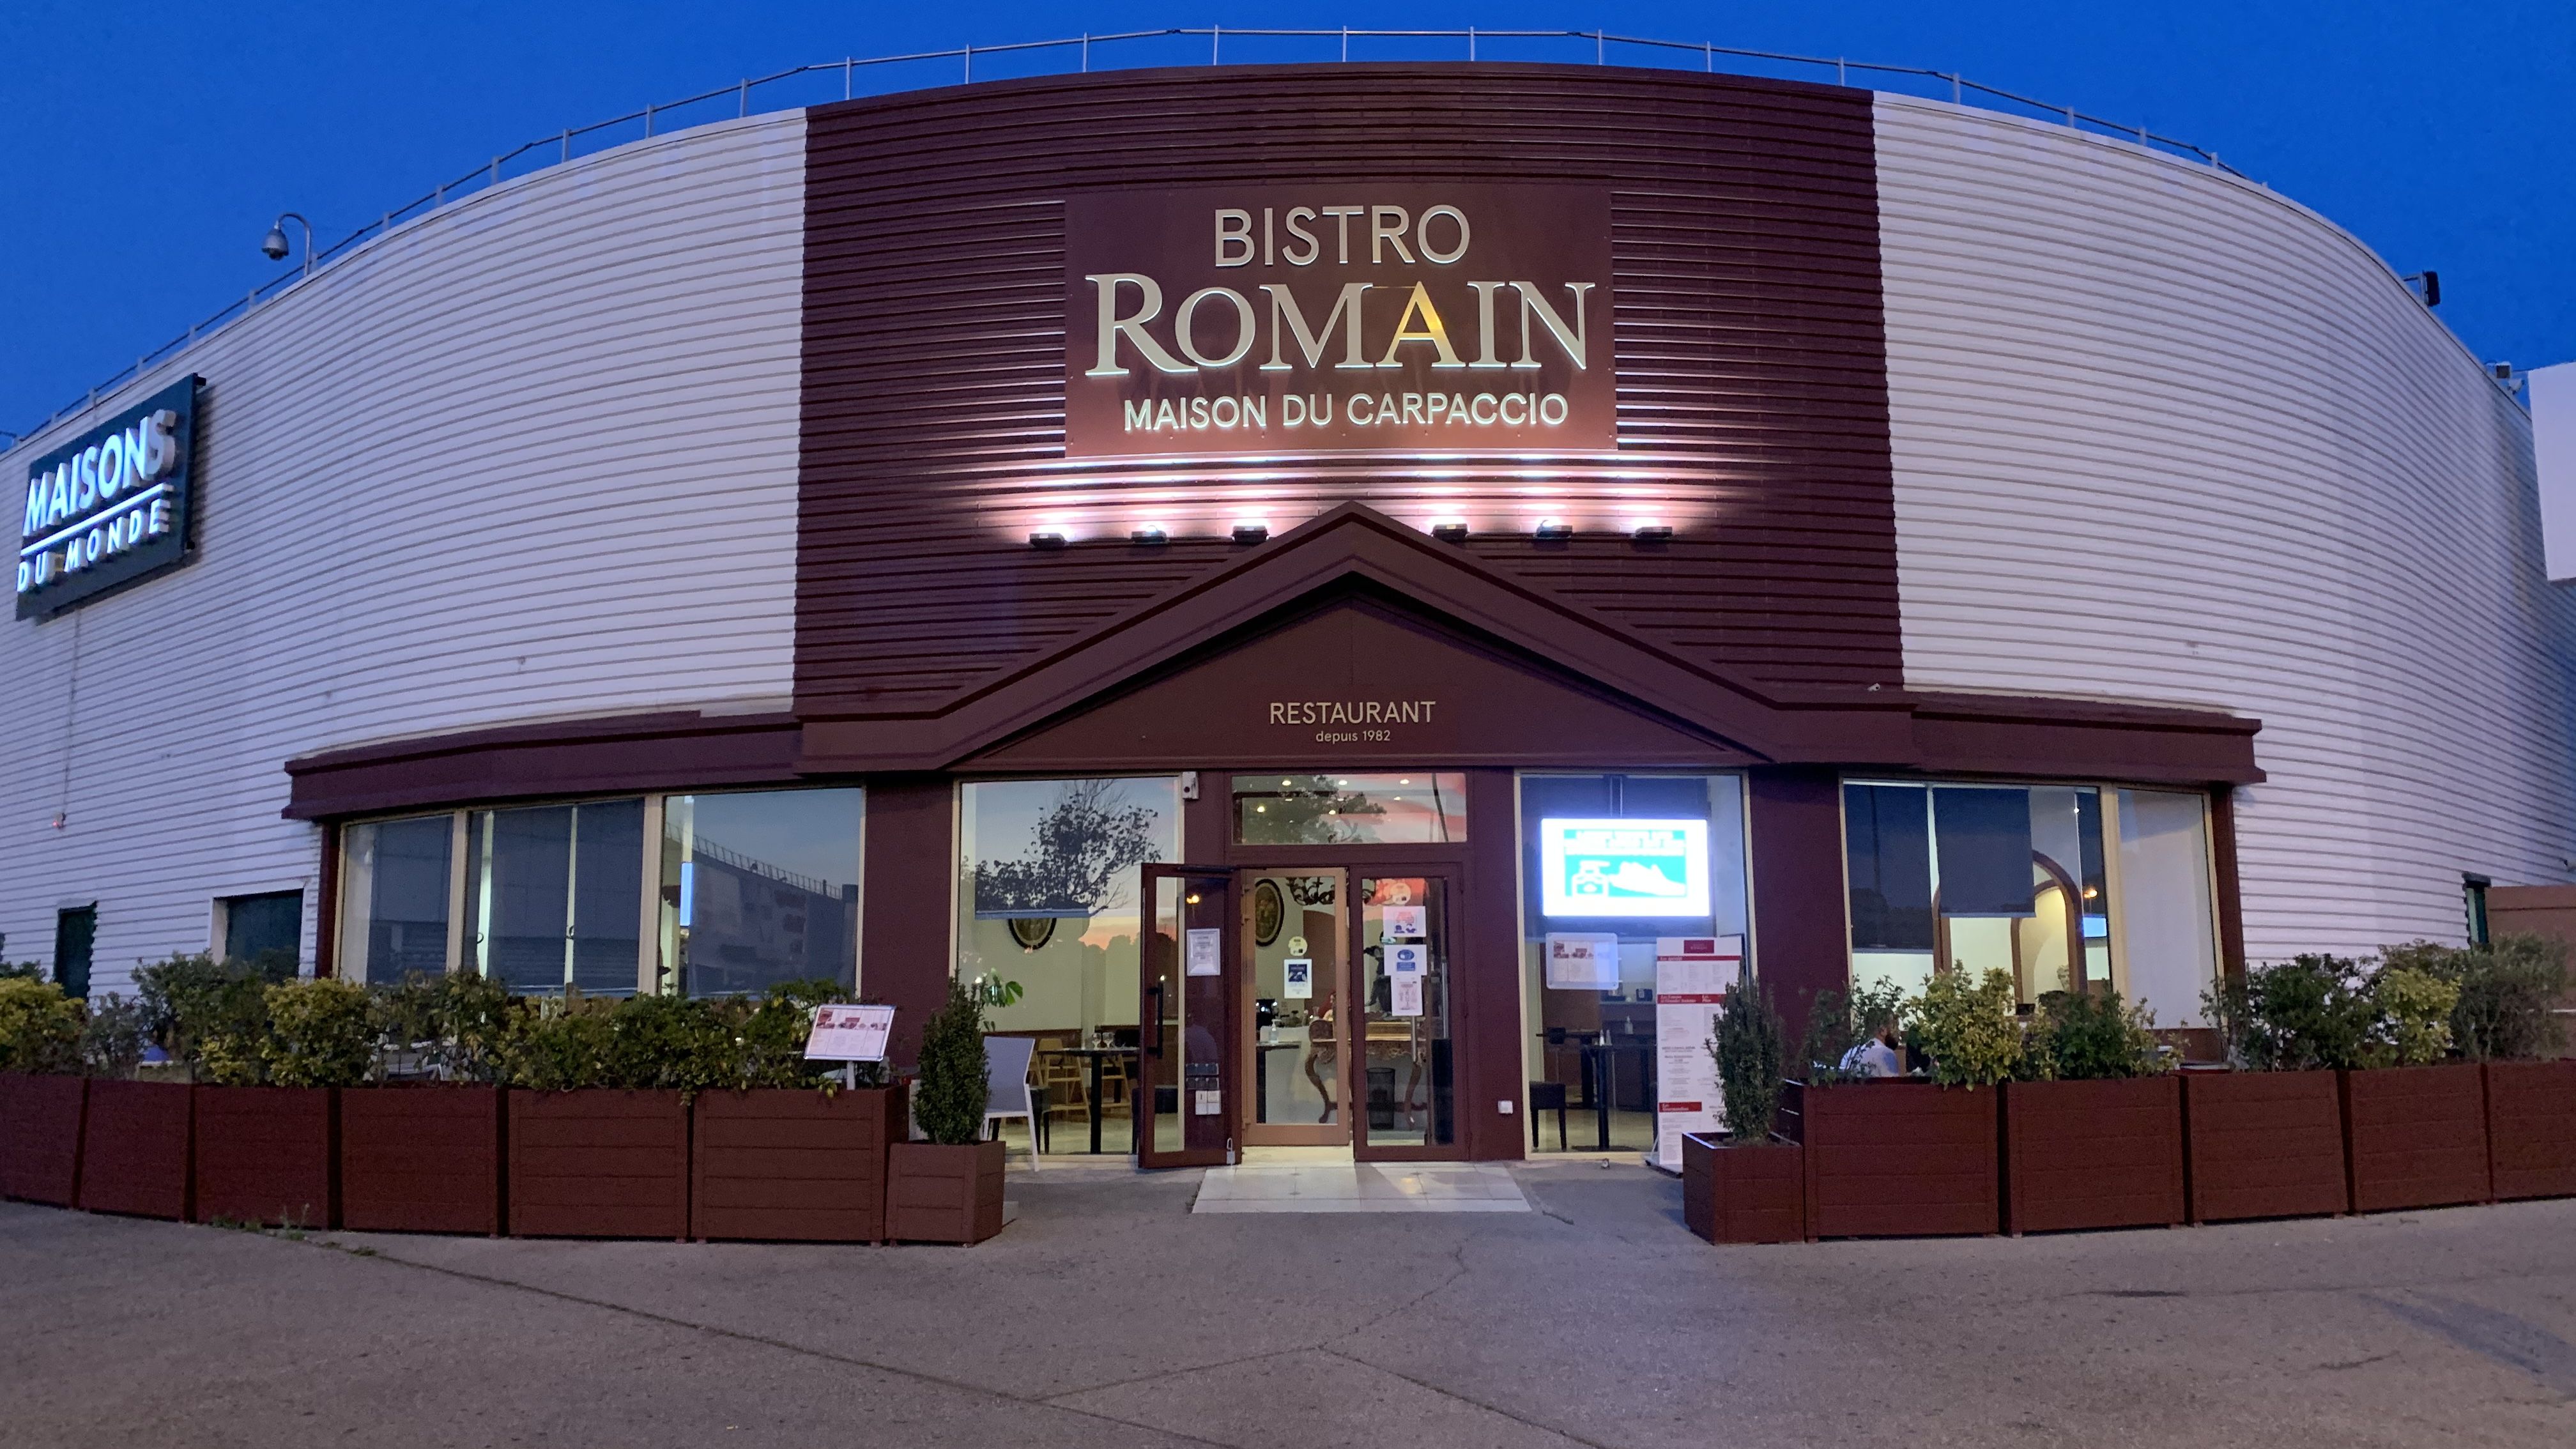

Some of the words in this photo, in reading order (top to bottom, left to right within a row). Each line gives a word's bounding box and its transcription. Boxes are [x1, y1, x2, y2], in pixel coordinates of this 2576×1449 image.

[1215, 205, 1470, 266] BISTRO
[1085, 273, 1595, 376] ROMAIN
[1124, 395, 1266, 432] MAISON
[1282, 394, 1333, 426] DU
[1347, 392, 1568, 425] CARPACCIO
[22, 409, 175, 537] MAISONS
[17, 551, 51, 592] DU
[64, 498, 170, 572] MONDE
[1270, 701, 1436, 724] RESTAURANT
[1315, 730, 1358, 744] depuis
[1362, 730, 1391, 742] 1982
